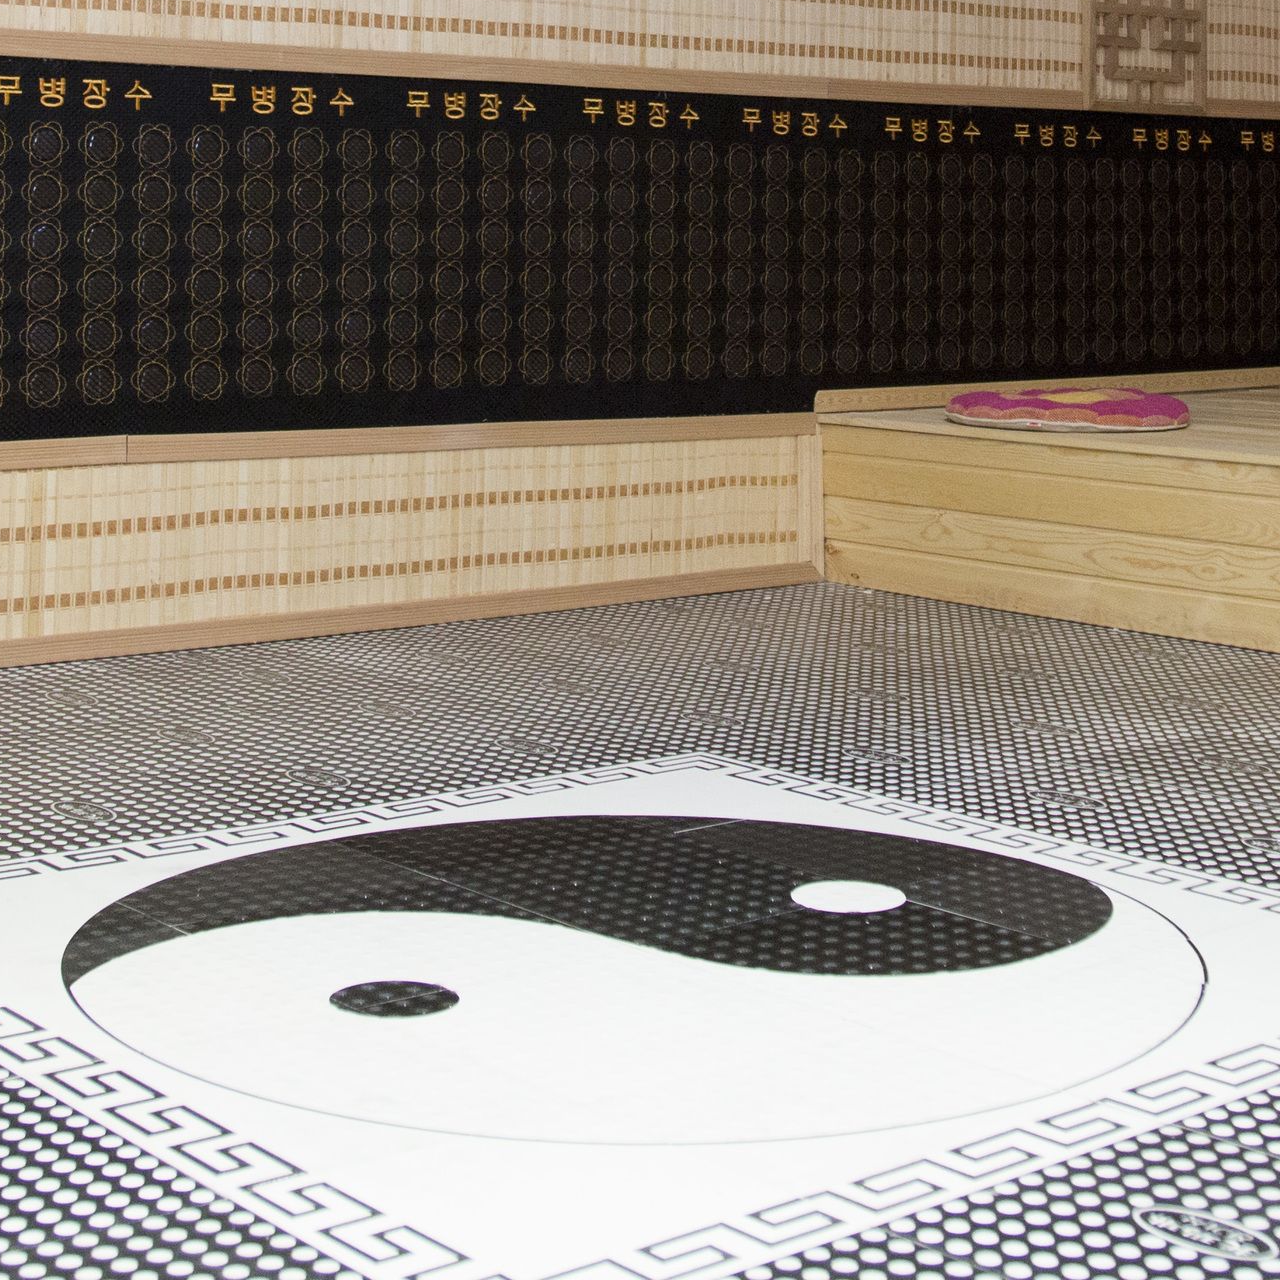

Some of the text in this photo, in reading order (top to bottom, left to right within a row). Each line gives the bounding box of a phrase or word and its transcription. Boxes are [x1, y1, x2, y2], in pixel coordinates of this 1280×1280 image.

[210, 84, 353, 116] 무병장수
[408, 91, 536, 120] 무병장수
[583, 98, 698, 128] 무병장수
[744, 109, 847, 136] 무병장수
[885, 117, 979, 143] 무병장수
[1016, 124, 1101, 147] 무병장수
[1134, 129, 1212, 150] 무병장수
